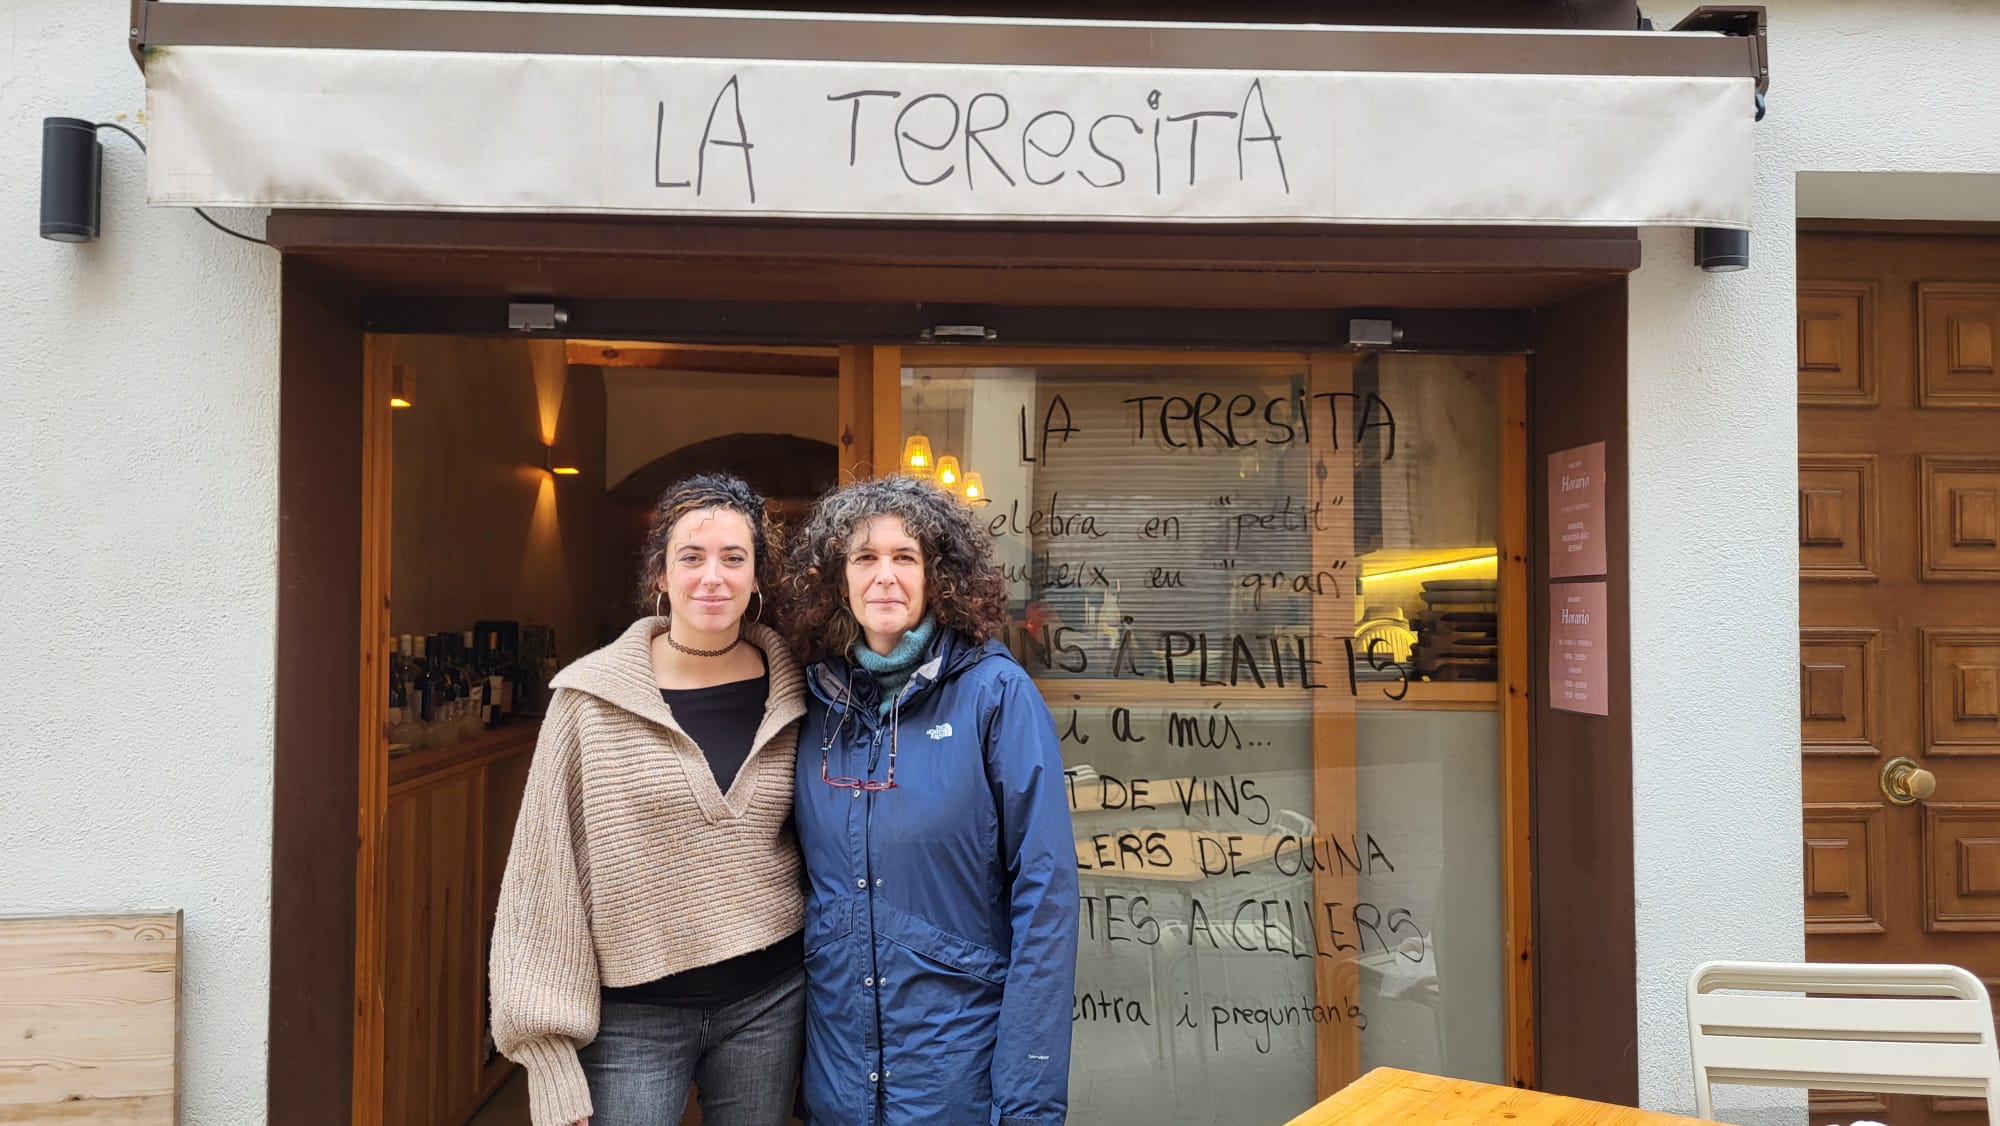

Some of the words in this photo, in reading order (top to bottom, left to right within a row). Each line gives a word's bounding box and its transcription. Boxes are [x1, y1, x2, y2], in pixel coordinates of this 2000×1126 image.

[655, 74, 755, 203] LA
[1021, 393, 1081, 466] LA
[970, 491, 1109, 538] elebra
[1144, 516, 1180, 541] en
[1561, 608, 1590, 625] Horario
[1002, 624, 1088, 674] INS
[1160, 630, 1409, 701] PLATETS
[1060, 694, 1090, 745] i
[1112, 707, 1146, 743] a
[1099, 774, 1156, 812] DE
[1175, 775, 1270, 826] VINS
[1198, 836, 1252, 879] DE
[1079, 895, 1161, 946] TES
[1232, 898, 1425, 964] CELLERS
[1176, 991, 1198, 1029] i
